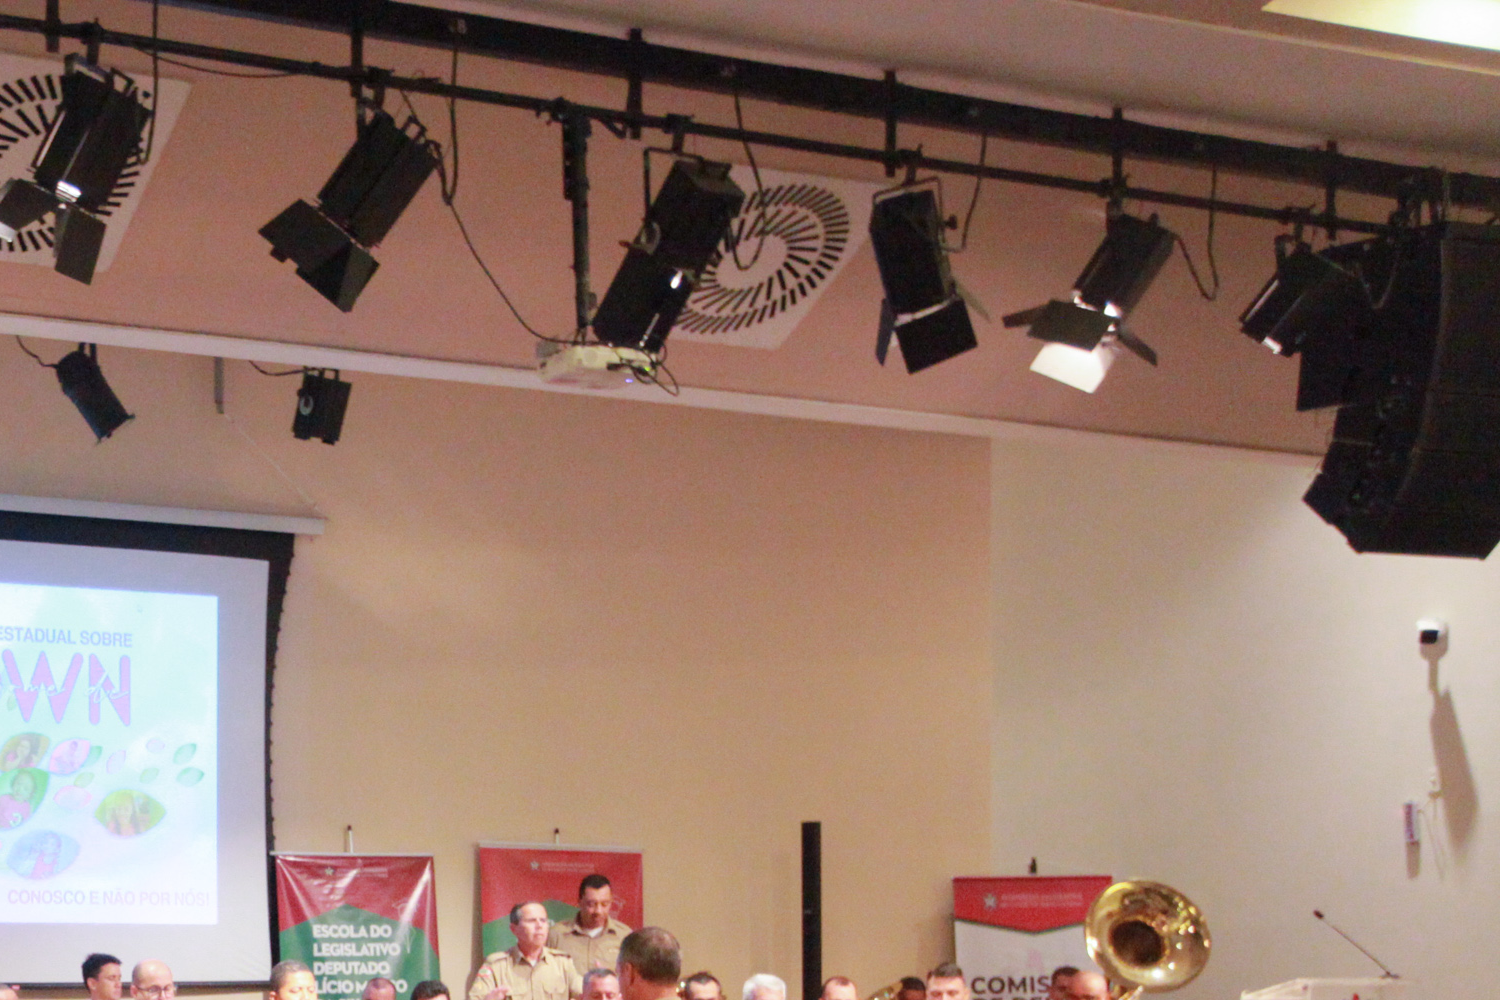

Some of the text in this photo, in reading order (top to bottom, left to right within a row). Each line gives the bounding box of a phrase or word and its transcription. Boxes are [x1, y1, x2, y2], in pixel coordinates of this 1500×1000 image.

[80, 630, 134, 648] SOBRE
[7, 887, 210, 908] CONOSCO E NÃO POR NÓS!
[312, 924, 393, 938] ESCOLA DO
[313, 943, 402, 957] LEGISLATIVO
[313, 961, 391, 975] DEPUTADO
[315, 976, 354, 994] LÍCIO
[971, 976, 1051, 995] COMIS
